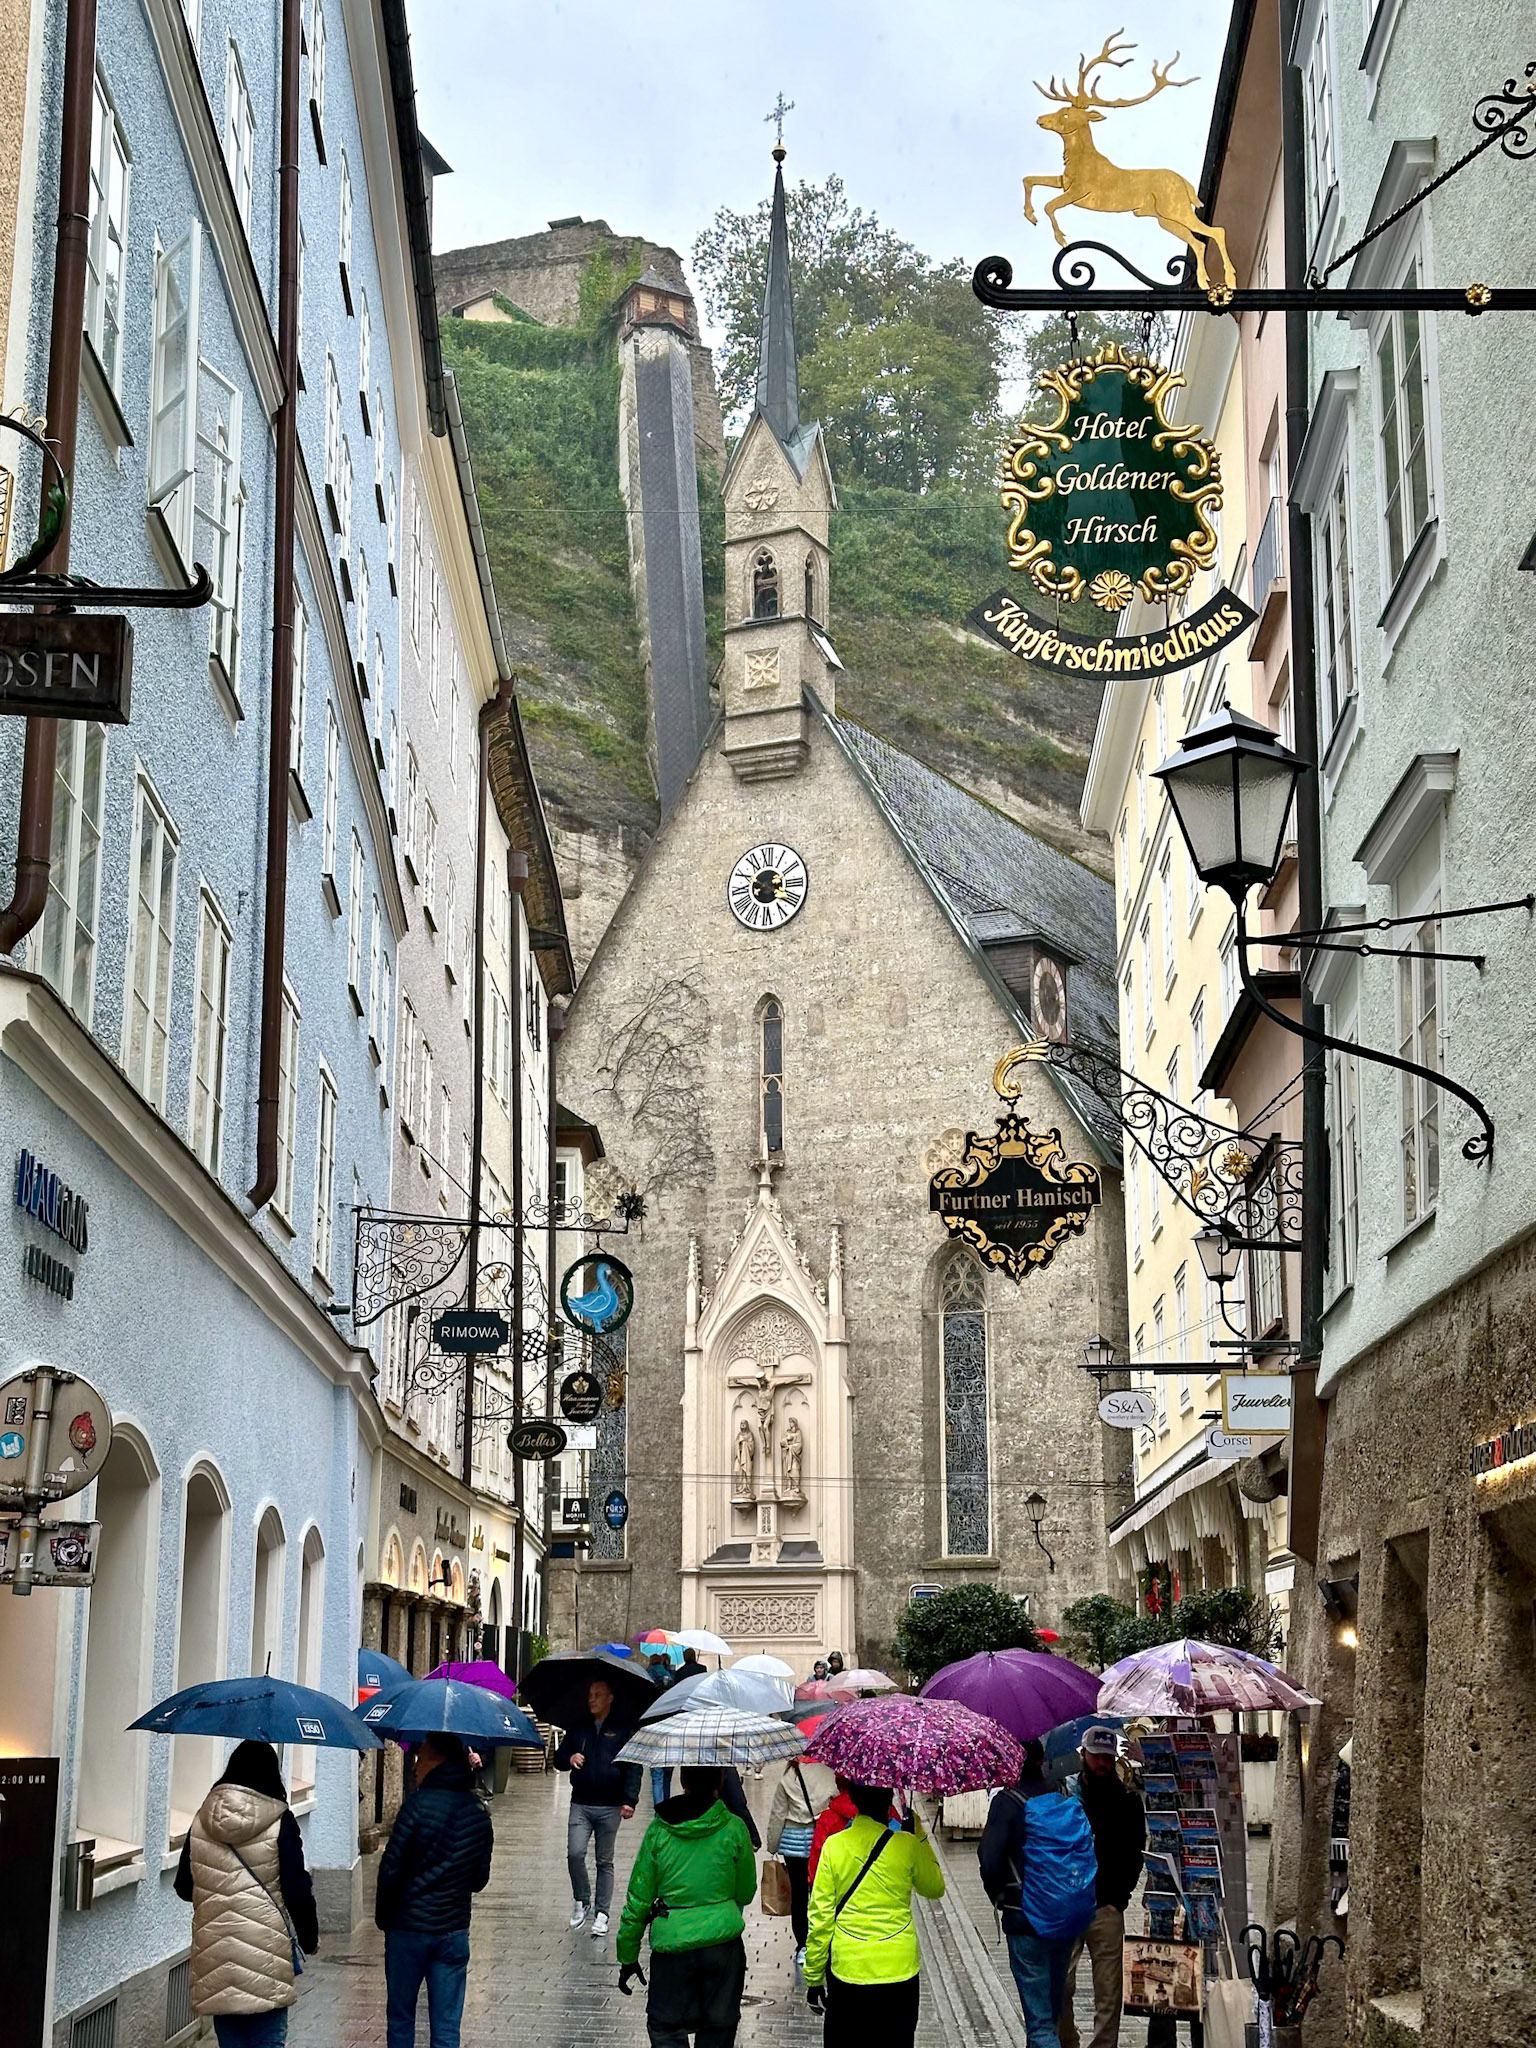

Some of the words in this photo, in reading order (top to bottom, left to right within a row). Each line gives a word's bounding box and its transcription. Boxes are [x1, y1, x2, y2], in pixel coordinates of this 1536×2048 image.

[1071, 412, 1153, 442] Hotel
[1055, 461, 1176, 496] Goldener
[1063, 515, 1159, 545] Hirsch
[984, 598, 1243, 672] Kupferschmiedhaus
[937, 1191, 1011, 1211] Furtner
[1016, 1186, 1094, 1208] Hanisch
[994, 1220, 1011, 1229] seit
[1013, 1219, 1039, 1229] 1955
[440, 1326, 500, 1338] RIMOWA
[1107, 1399, 1145, 1414] S&A
[516, 1432, 557, 1448] Bellas
[302, 1724, 320, 1735] 1350
[28, 1775, 46, 1784] UHR
